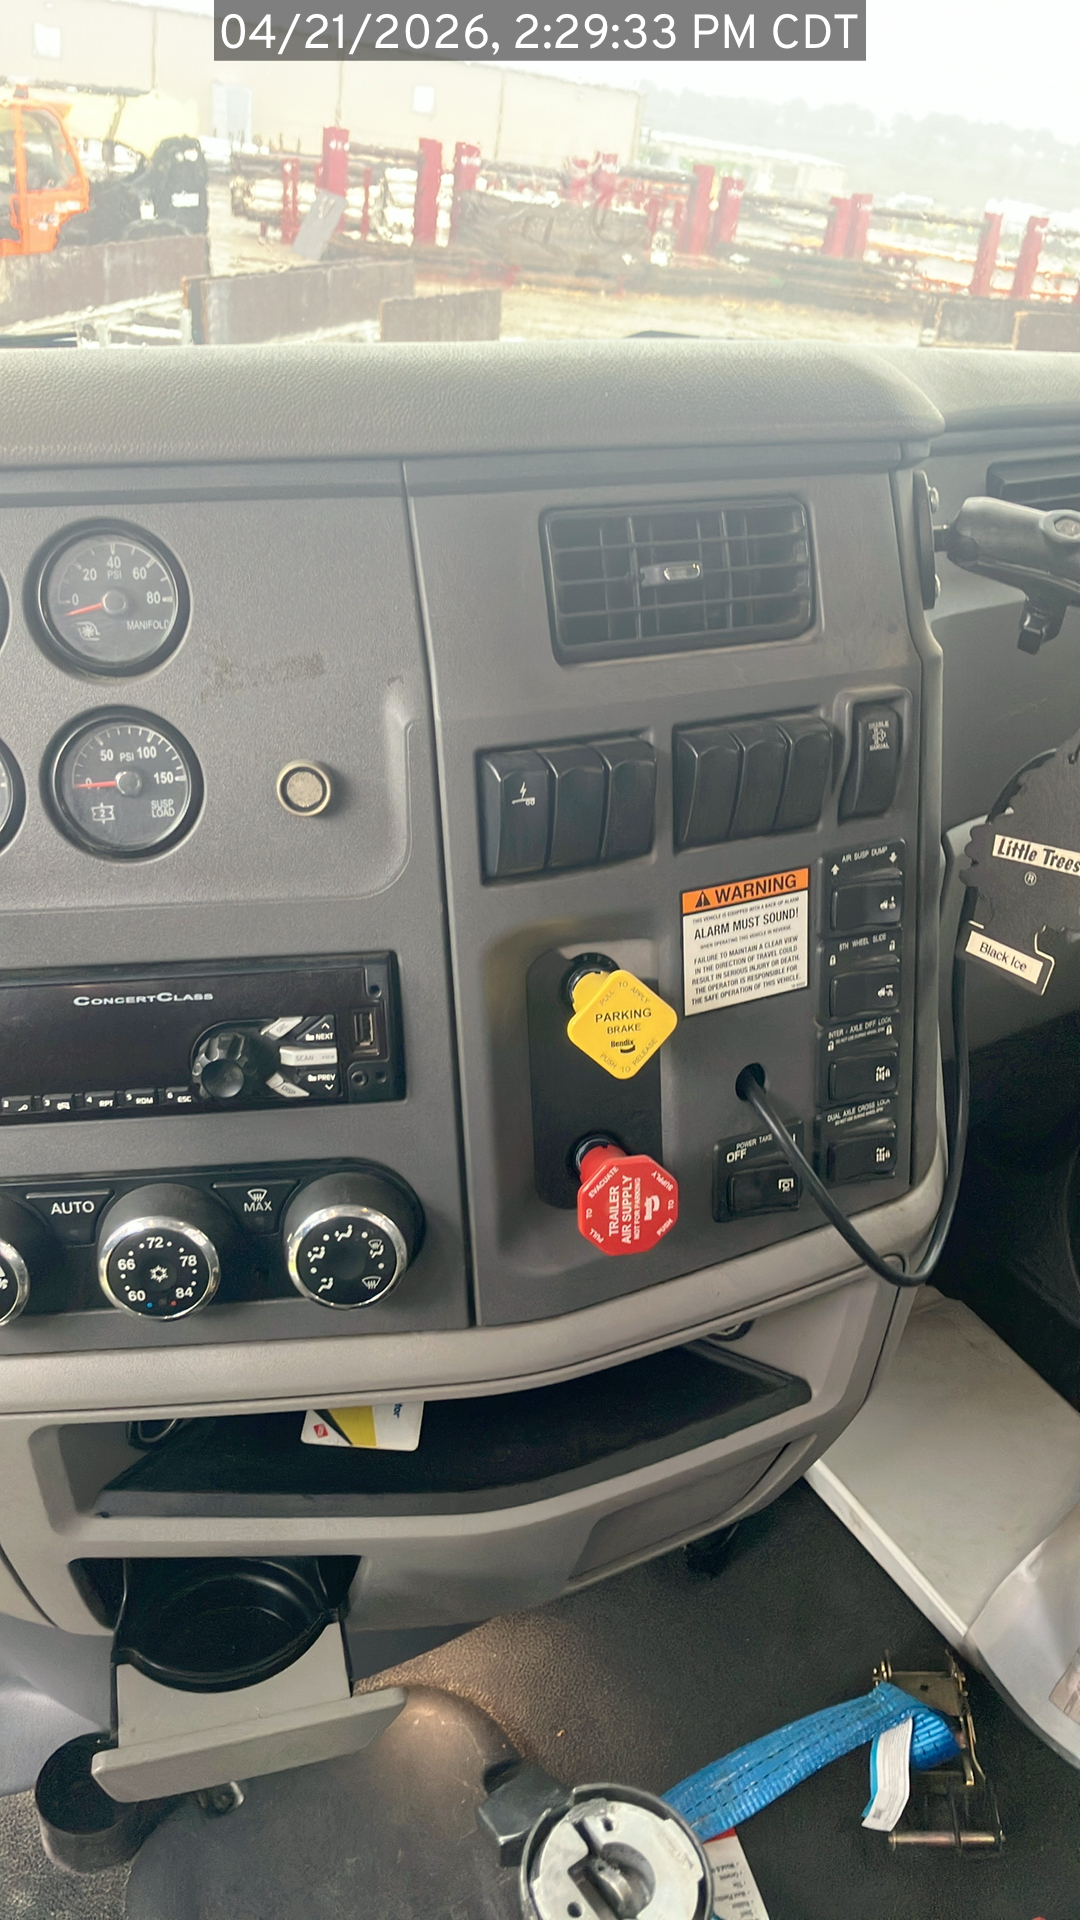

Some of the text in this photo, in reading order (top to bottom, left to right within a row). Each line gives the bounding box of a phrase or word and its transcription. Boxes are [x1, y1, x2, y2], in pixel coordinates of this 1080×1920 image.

[107, 556, 121, 569] 40
[83, 568, 97, 581] 20
[107, 570, 122, 580] PSI
[133, 567, 147, 580] 60
[72, 593, 79, 606] 0
[147, 591, 161, 604] 80
[127, 620, 170, 631] MANIFOLD
[100, 749, 114, 762] 50
[120, 752, 135, 762] PSI
[136, 746, 157, 759] 100
[153, 772, 174, 784] 150
[151, 799, 174, 810] SUSP
[152, 808, 175, 818] LOAD
[997, 838, 1080, 873] Little Trees
[715, 874, 797, 904] WARNING
[694, 907, 799, 940] ALARM MUST SOUND!
[851, 937, 869, 948] WHEEL
[694, 953, 717, 965] FAILURE
[720, 951, 728, 959] TO
[729, 945, 758, 956] MAINTAIN
[764, 939, 783, 949] CLEAR
[784, 935, 799, 944] VIEW
[979, 941, 1027, 972] Black Ice
[695, 967, 701, 975] IN
[703, 964, 713, 972] THE
[715, 957, 746, 970] DIRECTION
[756, 950, 777, 960] TRAVEL
[779, 945, 798, 955] COULD
[692, 974, 714, 986] RESULT
[723, 967, 748, 978] SERIOUS
[749, 961, 770, 972] INJURY
[771, 959, 779, 967] OR
[780, 954, 799, 965] DEATH
[695, 986, 706, 995] THE
[708, 979, 738, 992] OPERATOR
[747, 967, 785, 982] RESPONSIBLE
[786, 965, 798, 973] FOR
[599, 990, 616, 1006] PULL
[630, 987, 650, 1004] APPLY
[692, 997, 702, 1005] THE
[704, 993, 719, 1002] SAFE
[720, 985, 752, 998] OPERATION
[763, 979, 775, 988] THIS
[595, 1008, 652, 1023] PARKING
[607, 1023, 641, 1035] BRAKE
[850, 1023, 863, 1034] AXLE
[878, 1016, 892, 1026] LOCK
[610, 1039, 635, 1048] Bendix
[600, 1053, 617, 1069] PUSH
[632, 1038, 658, 1066] RELEASE
[99, 1100, 113, 1108] RPT
[135, 1097, 153, 1105] RDM
[827, 1111, 841, 1123] DUAL
[842, 1106, 856, 1117] AXLE
[857, 1101, 875, 1113] CROSS
[736, 1133, 773, 1150] POWER TAKE
[726, 1148, 747, 1163] OFF
[50, 1202, 95, 1216] AUTO
[243, 1200, 273, 1212] MAX
[586, 1166, 619, 1244] PULL TO EVACUATE
[621, 1175, 633, 1244] AIR SUPPLY
[651, 1170, 674, 1236] PUSH TO SUPPLY
[608, 1185, 620, 1237] TRAILER
[146, 1236, 164, 1249] 72
[117, 1258, 136, 1271] 66
[179, 1255, 197, 1268] 78
[128, 1289, 146, 1302] 60
[175, 1286, 193, 1299] 84
